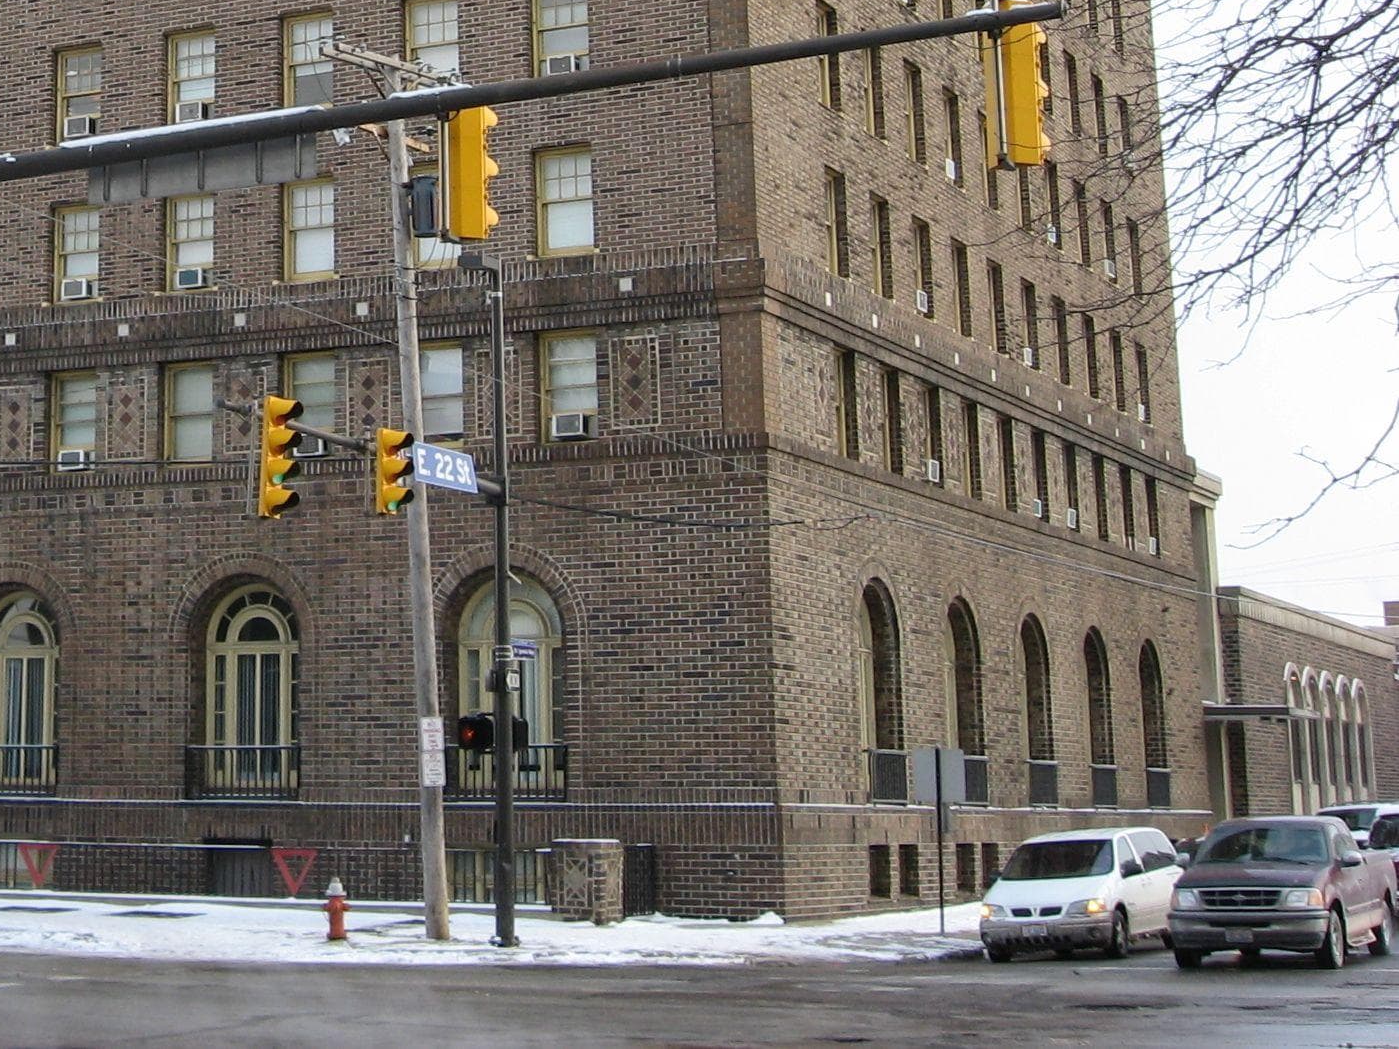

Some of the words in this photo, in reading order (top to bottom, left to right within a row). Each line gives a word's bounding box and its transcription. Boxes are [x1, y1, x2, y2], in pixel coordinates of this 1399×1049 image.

[417, 448, 431, 476] E.
[434, 452, 455, 482] 22
[456, 457, 472, 486] St
